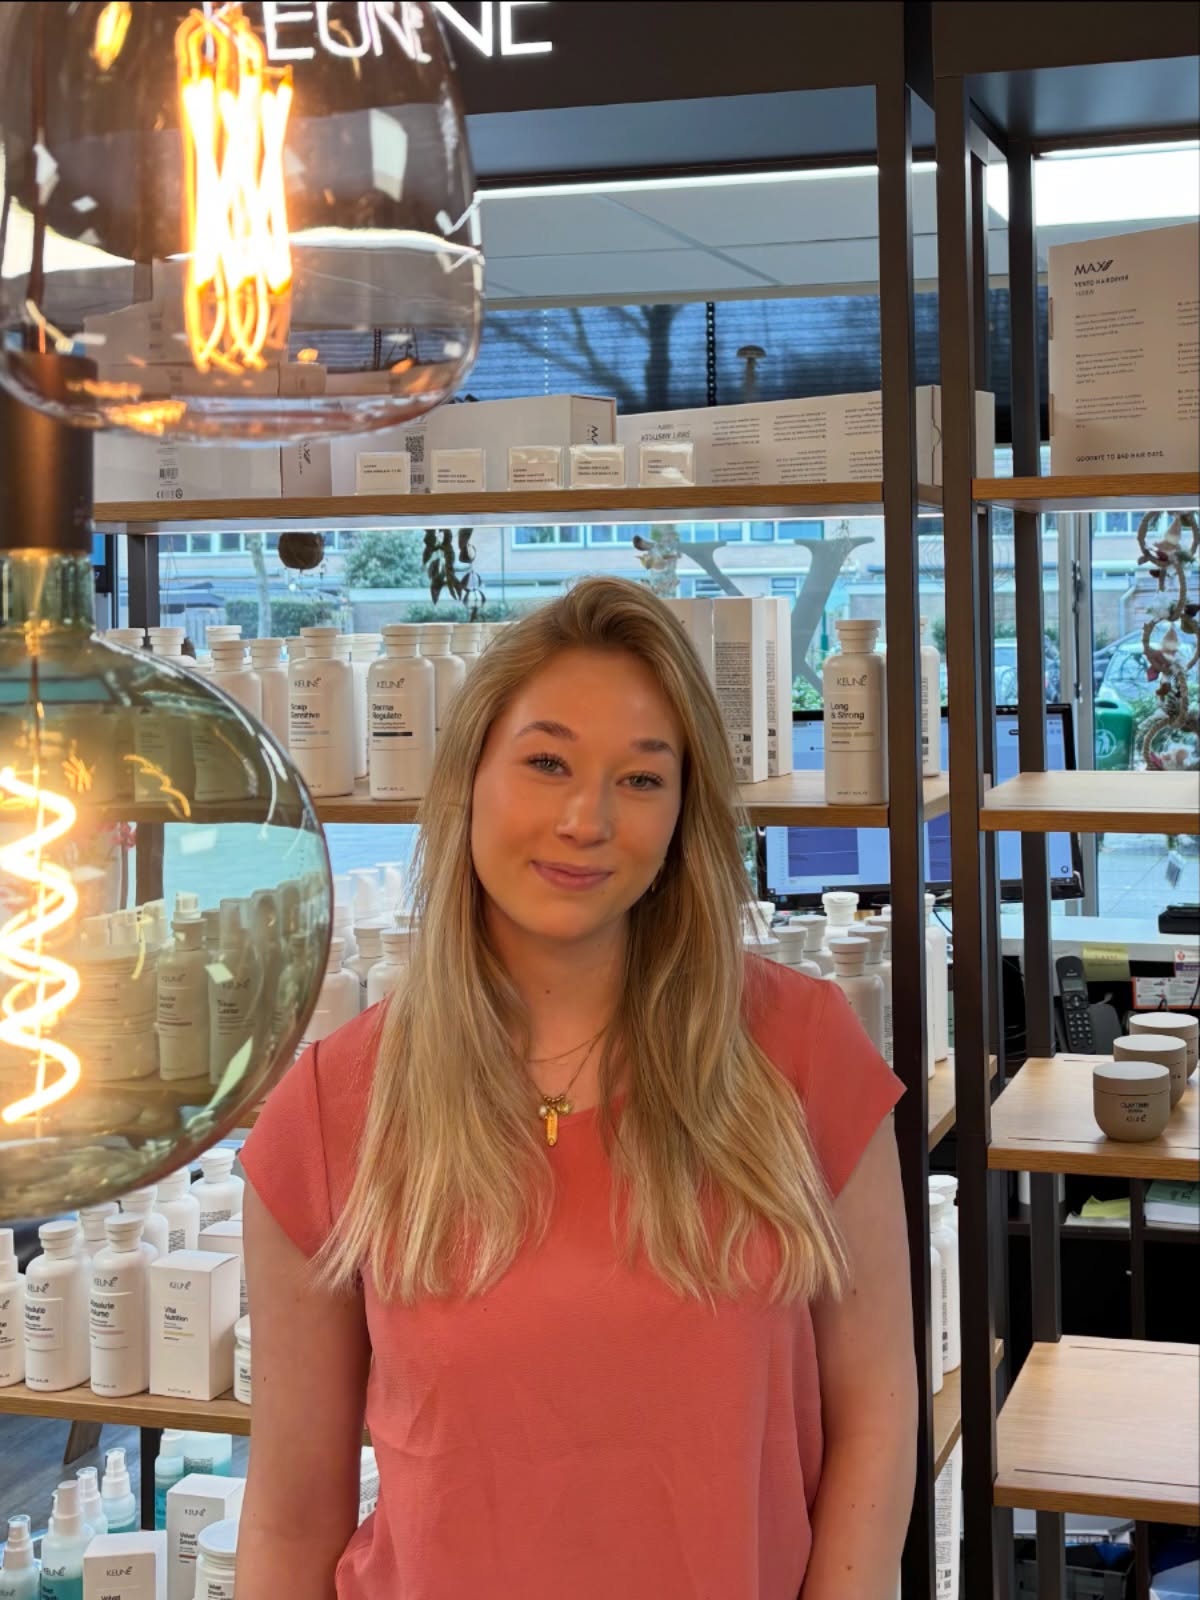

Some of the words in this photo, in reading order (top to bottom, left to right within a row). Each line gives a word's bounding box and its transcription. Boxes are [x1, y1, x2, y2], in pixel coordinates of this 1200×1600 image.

[1106, 453, 1116, 461] TO
[830, 702, 849, 712] Long
[372, 711, 402, 720] Regulate
[838, 711, 865, 720] Strong
[164, 1313, 189, 1322] Nutrition
